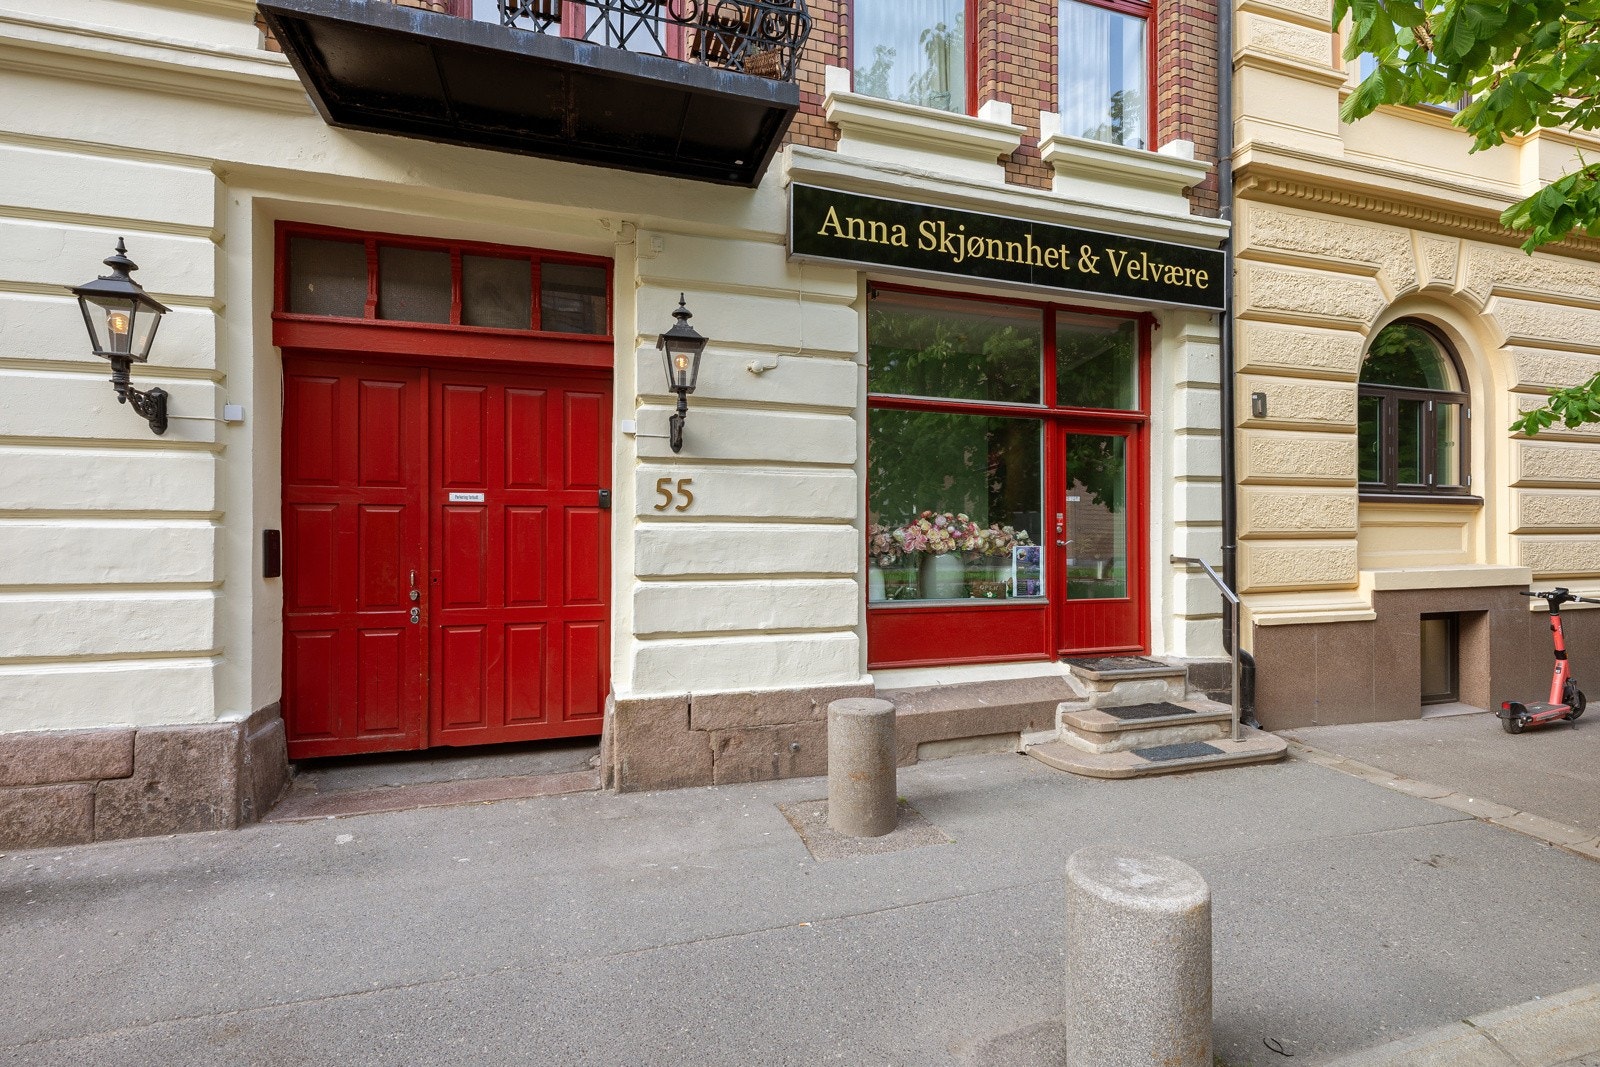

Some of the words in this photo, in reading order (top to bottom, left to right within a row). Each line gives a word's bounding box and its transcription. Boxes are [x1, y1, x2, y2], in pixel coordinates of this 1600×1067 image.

[817, 205, 908, 249] Anna
[917, 219, 1071, 272] Skjønnhet
[1077, 244, 1100, 275] &
[1105, 248, 1209, 290] Velvære
[653, 477, 694, 511] 55
